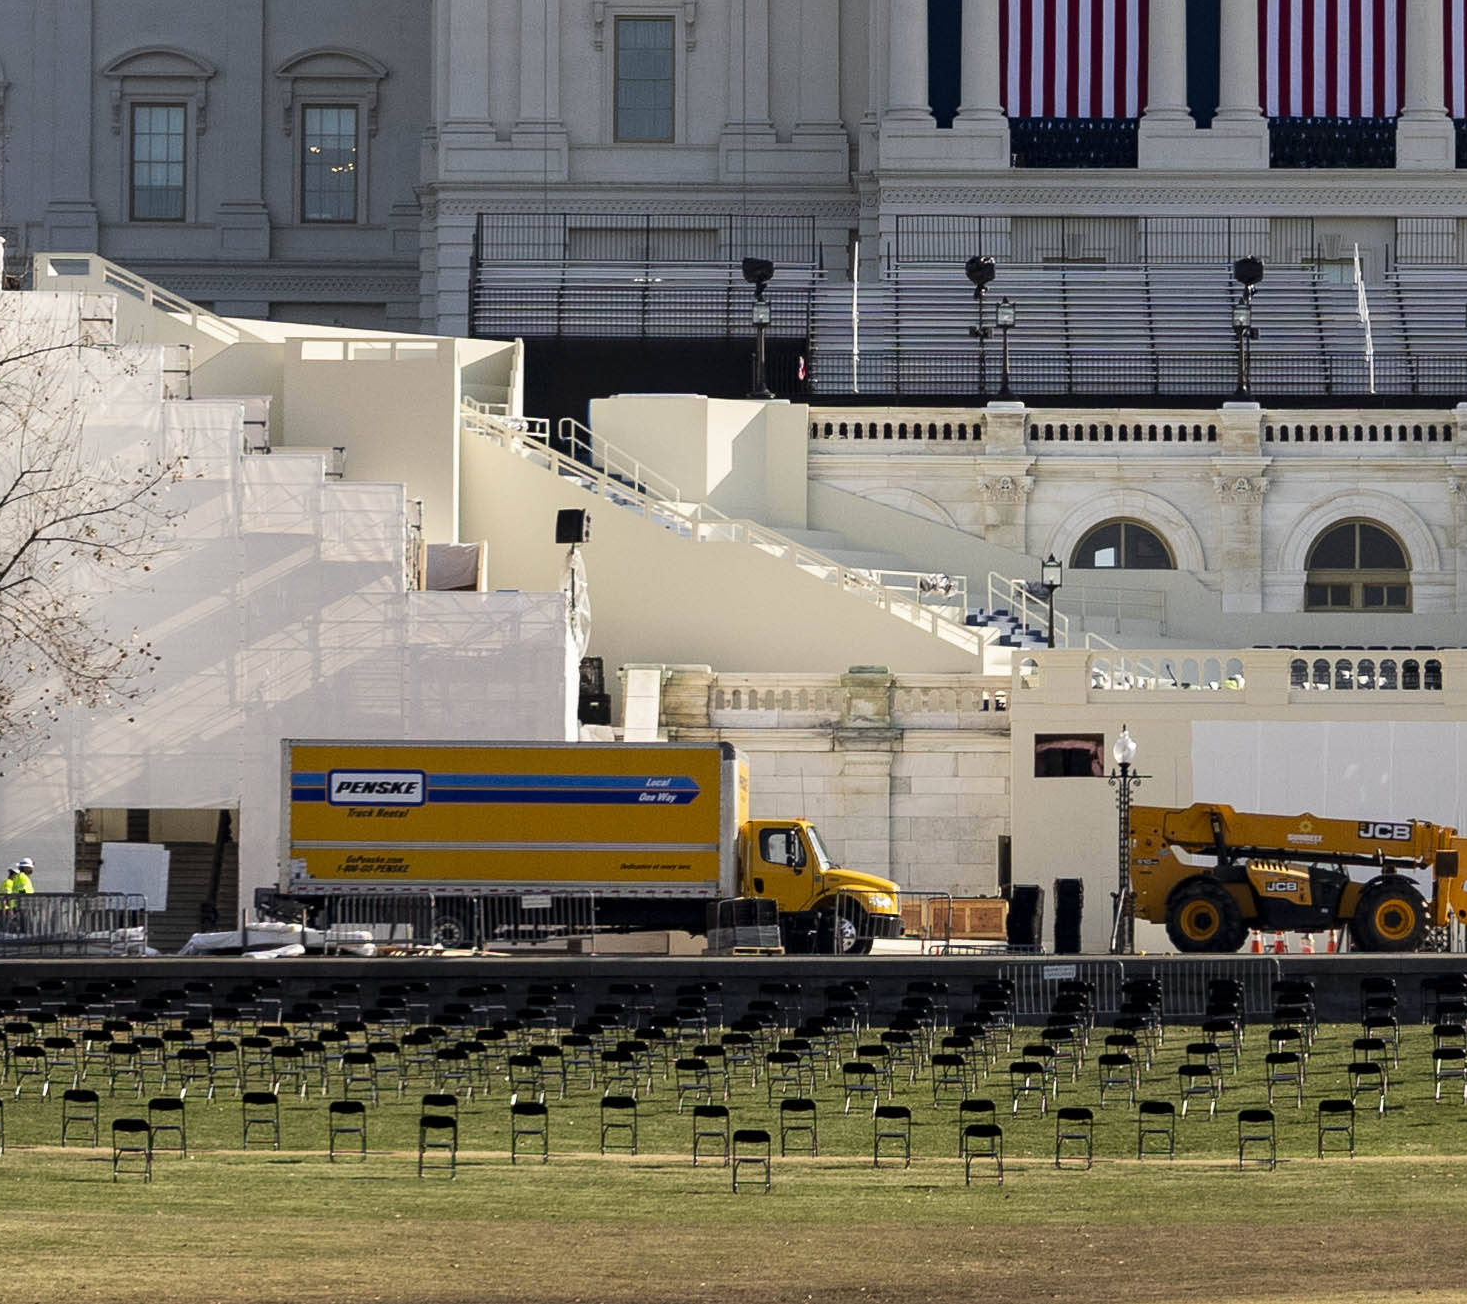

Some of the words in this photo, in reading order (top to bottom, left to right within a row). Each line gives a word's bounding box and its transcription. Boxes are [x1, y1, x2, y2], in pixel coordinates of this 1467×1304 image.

[335, 781, 420, 795] PENSKE
[646, 778, 672, 788] Local
[657, 792, 677, 803] Way
[347, 808, 372, 818] Truck
[1359, 823, 1411, 840] JCB
[1266, 882, 1297, 891] JCB
